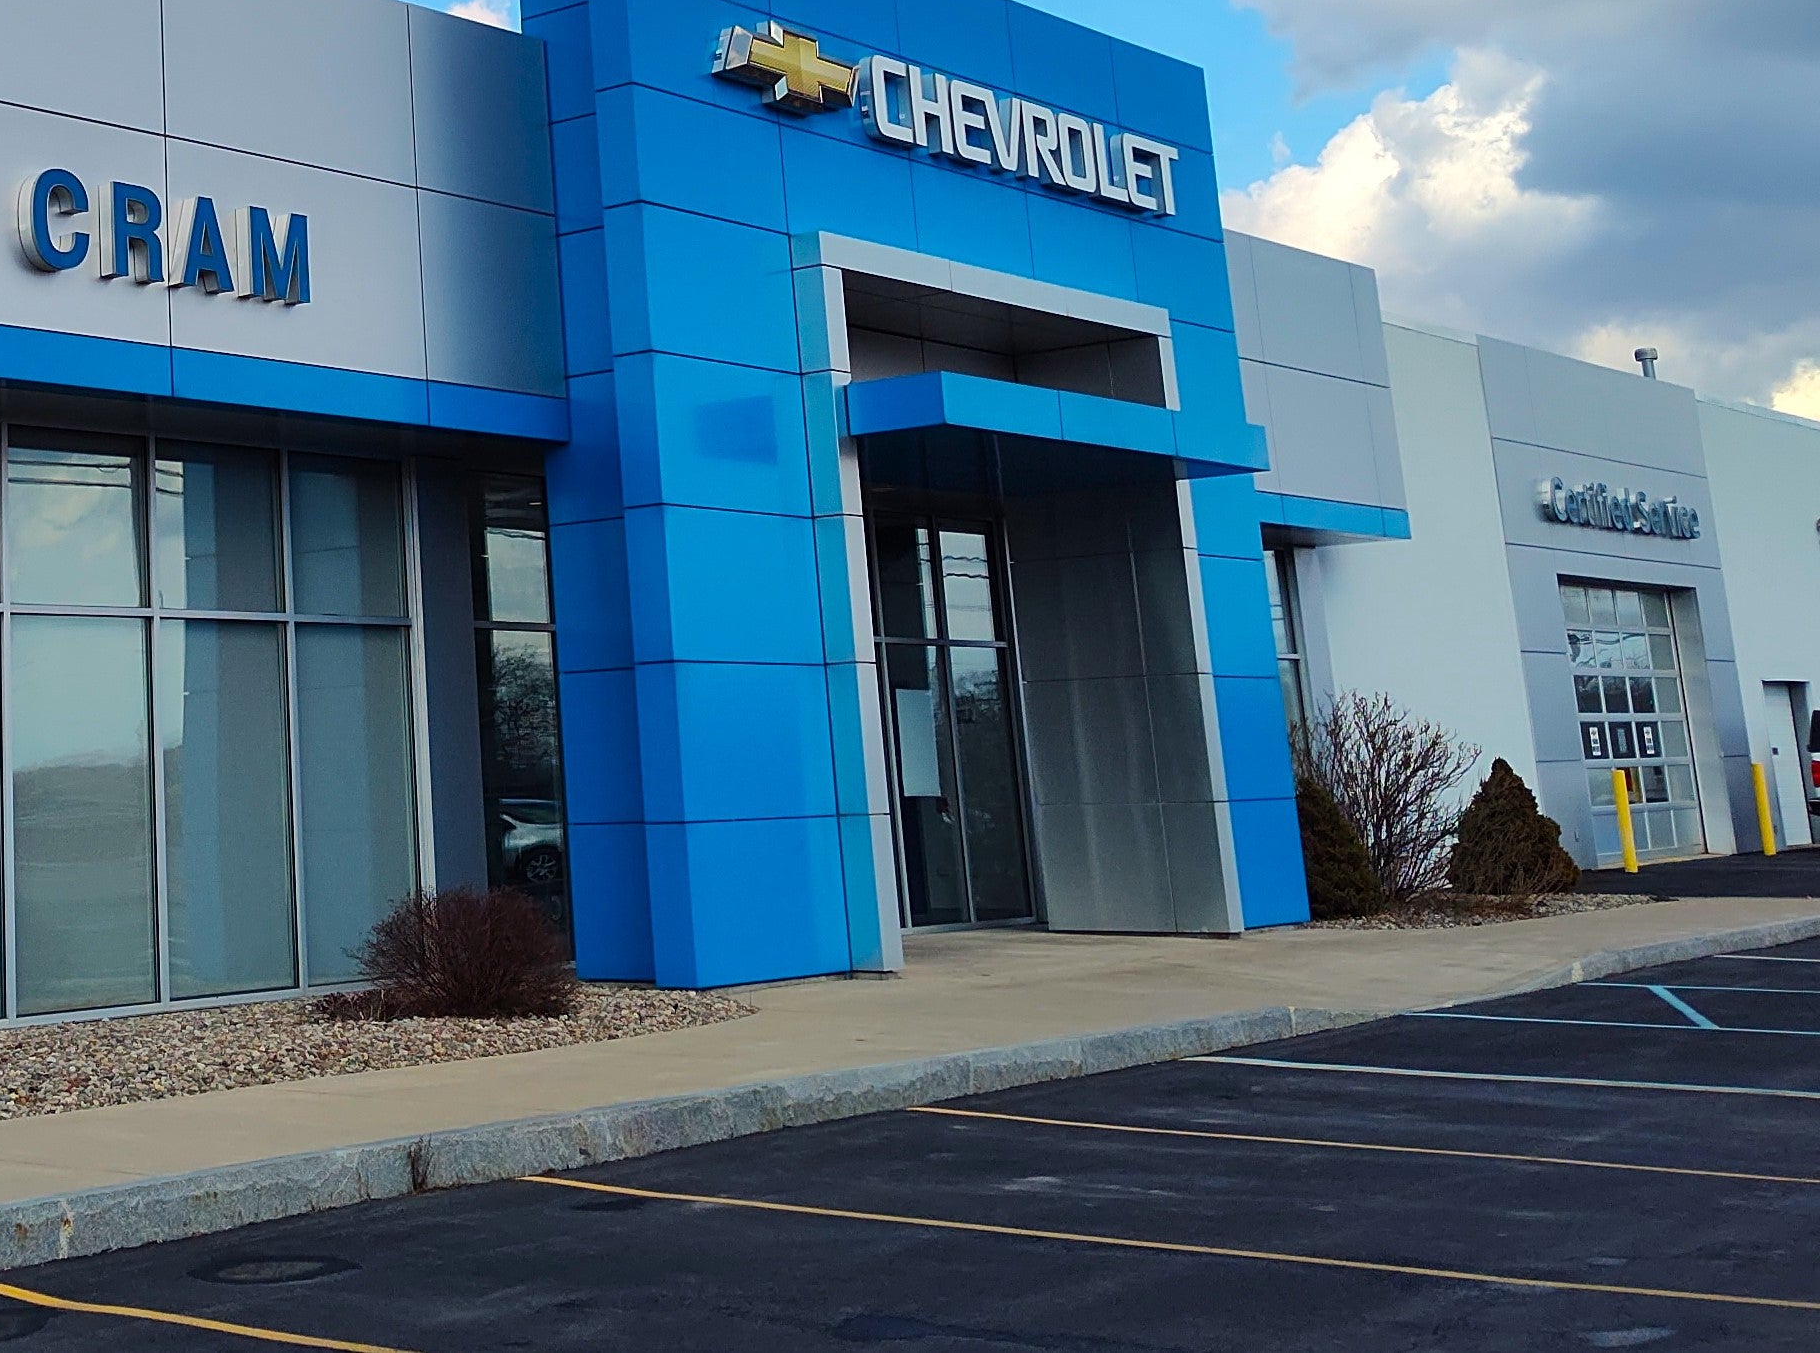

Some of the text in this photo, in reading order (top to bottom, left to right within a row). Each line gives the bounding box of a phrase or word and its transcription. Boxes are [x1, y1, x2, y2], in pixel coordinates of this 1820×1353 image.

[861, 54, 1179, 216] CHEVROLET
[20, 168, 311, 305] CRAM
[1546, 476, 1701, 540] Certified Service
